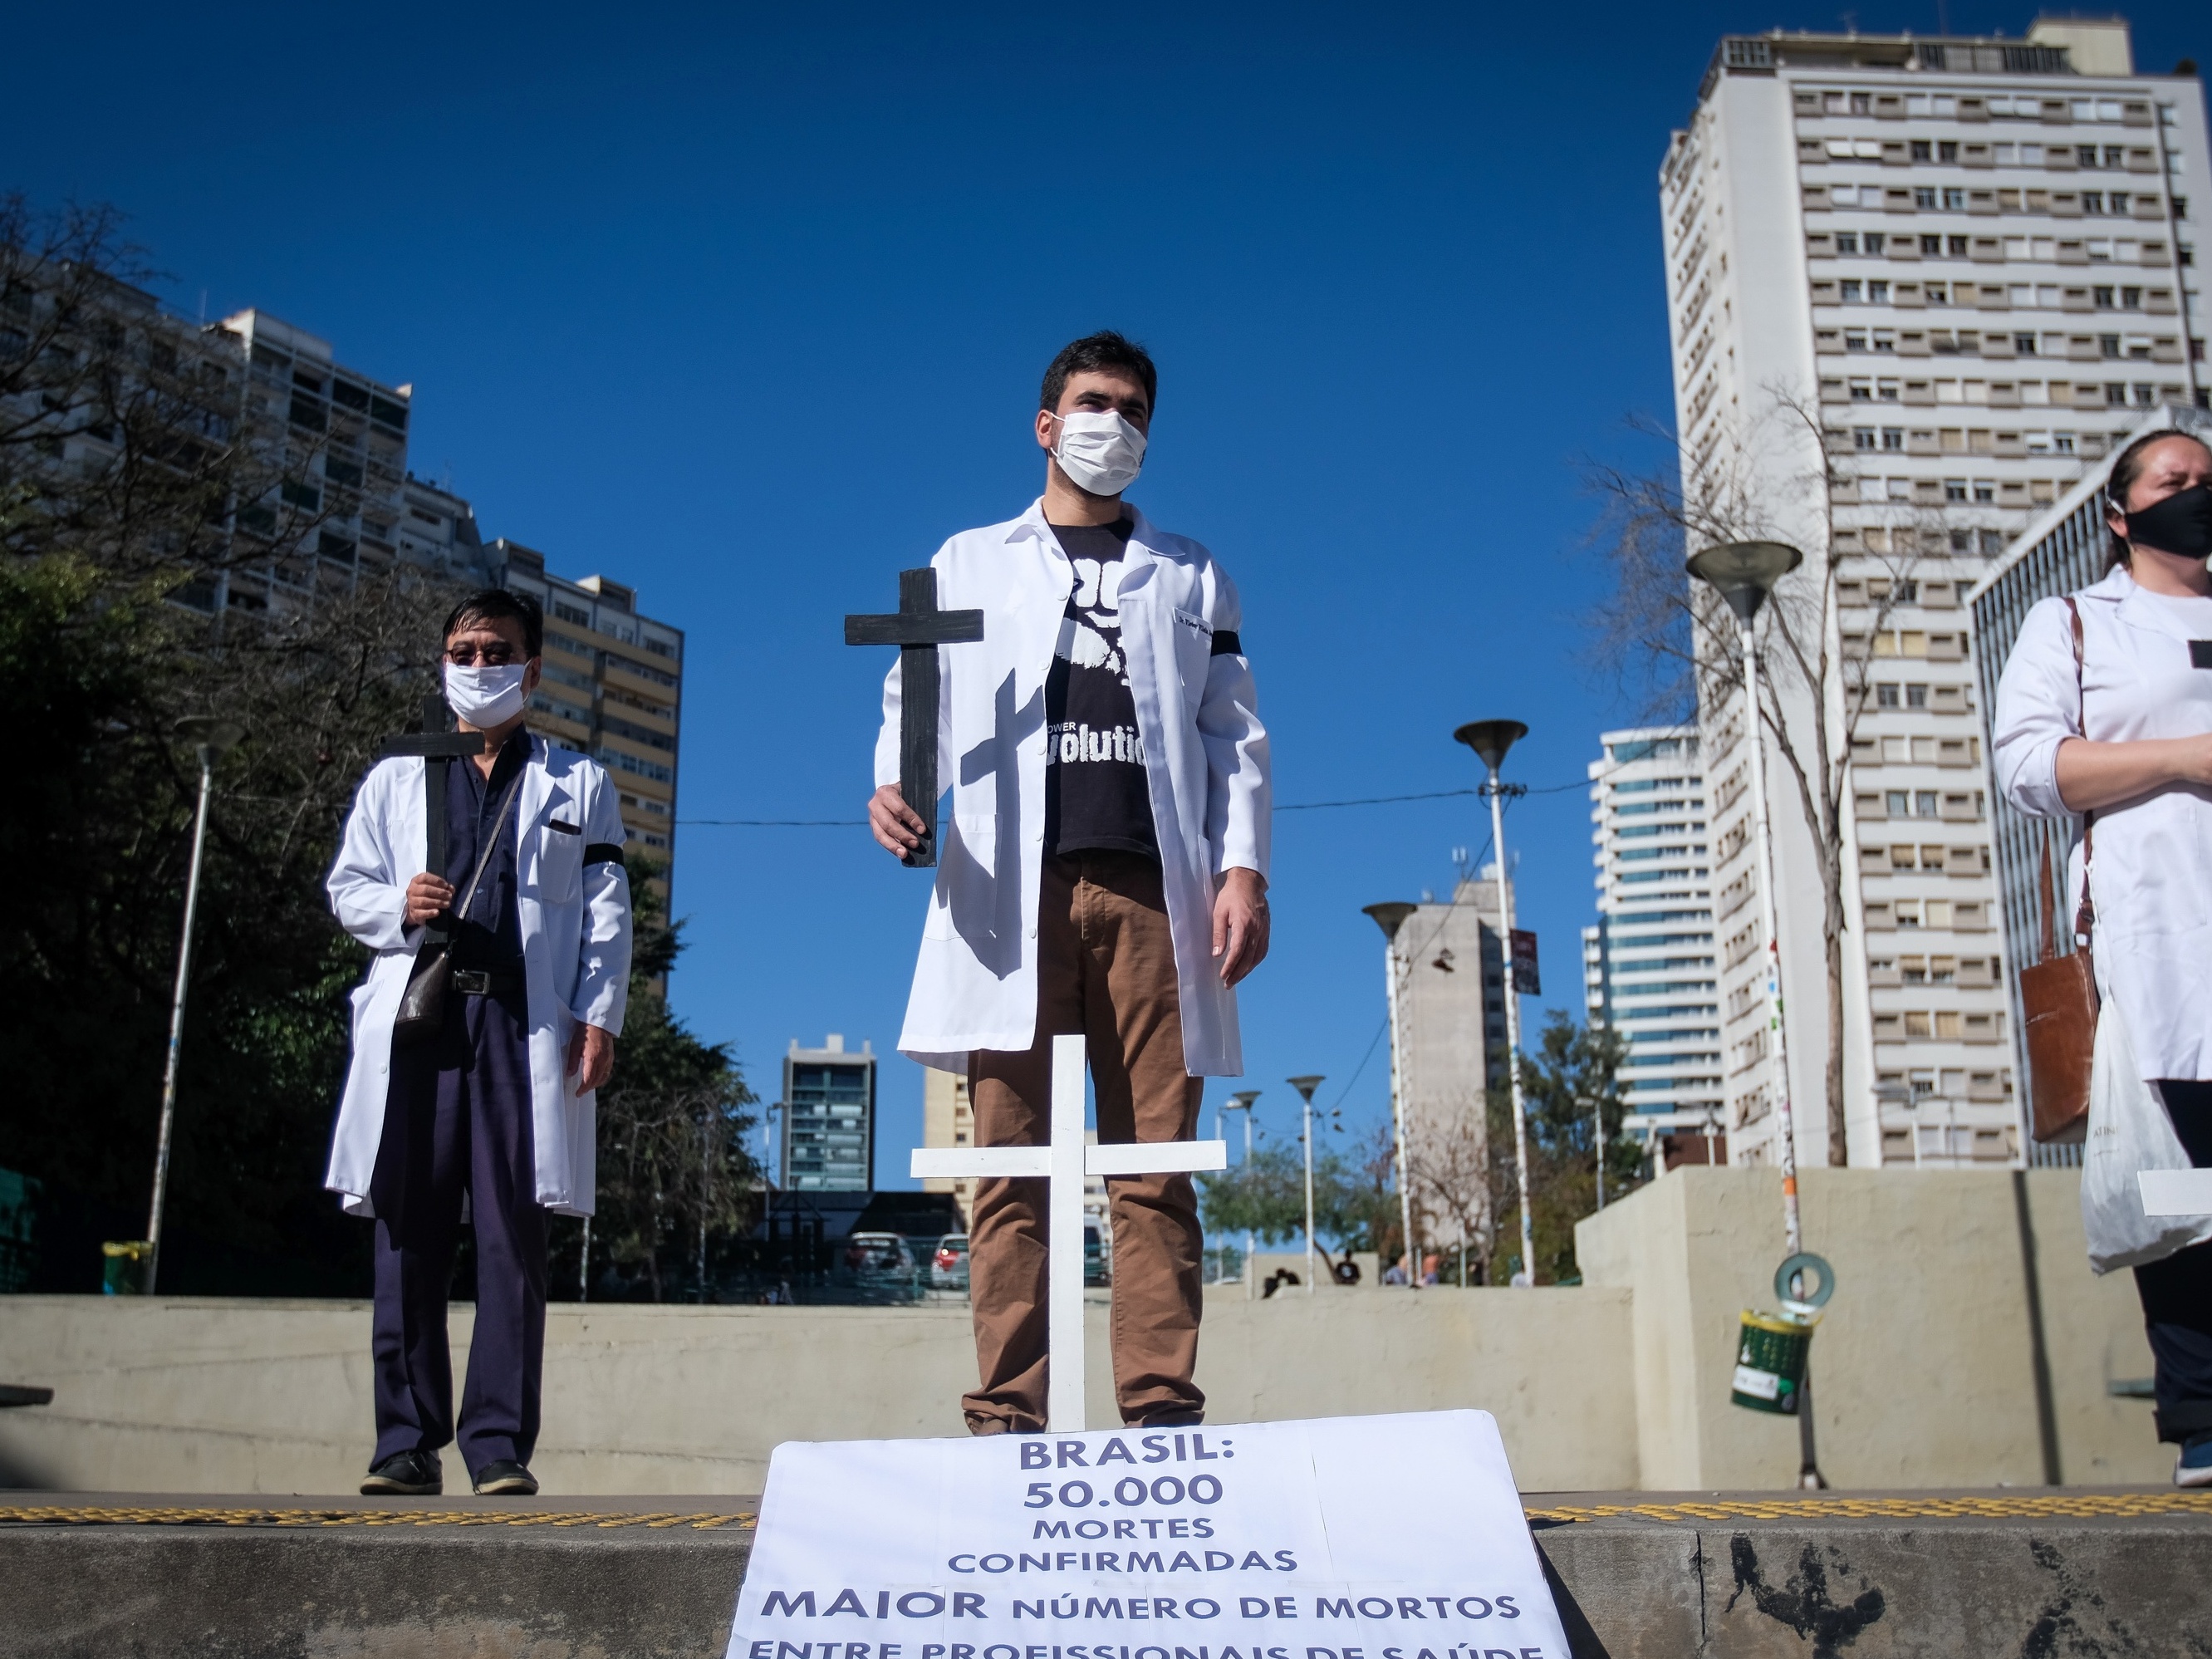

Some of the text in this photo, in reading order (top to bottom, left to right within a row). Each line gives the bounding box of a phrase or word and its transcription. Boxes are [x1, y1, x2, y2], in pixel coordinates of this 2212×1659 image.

[1047, 721, 1077, 734] OWER
[1020, 1433, 1235, 1470] BRASIL:
[1023, 1474, 1224, 1509] 50.000
[1032, 1517, 1214, 1540] MORTES
[948, 1549, 1297, 1573] CONFIRMADAS
[760, 1588, 1521, 1621] MAIOR NÚMERO DE MORTOS
[748, 1640, 902, 1659] ENTRE
